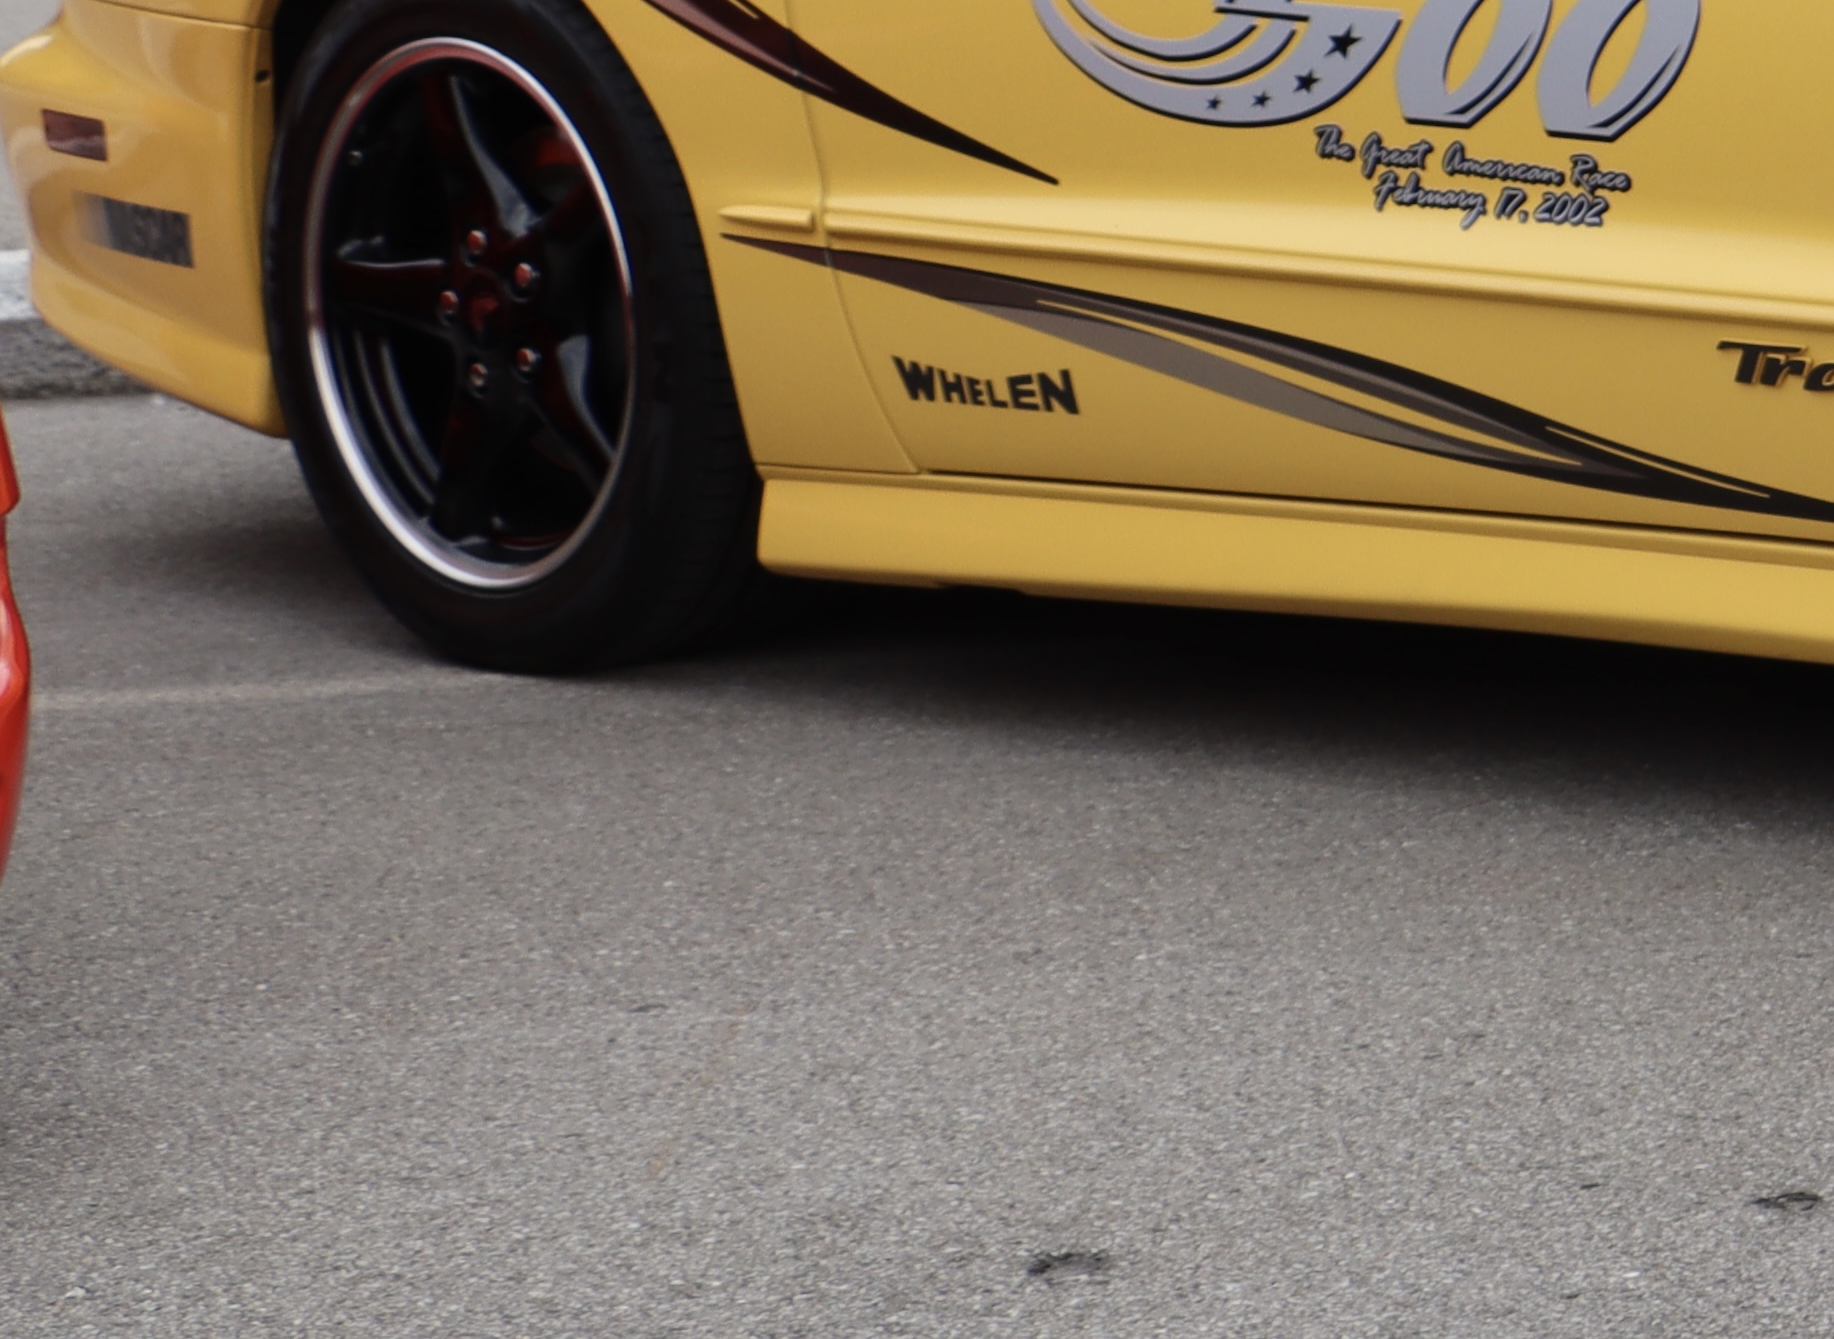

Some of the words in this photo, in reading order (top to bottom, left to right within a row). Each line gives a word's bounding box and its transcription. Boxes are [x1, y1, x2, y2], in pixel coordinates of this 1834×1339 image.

[1314, 124, 1355, 162] The
[1360, 131, 1434, 180] Great
[1441, 140, 1565, 187] American
[1569, 153, 1632, 194] Race
[1373, 170, 1487, 231] February
[1533, 193, 1610, 228] 2002
